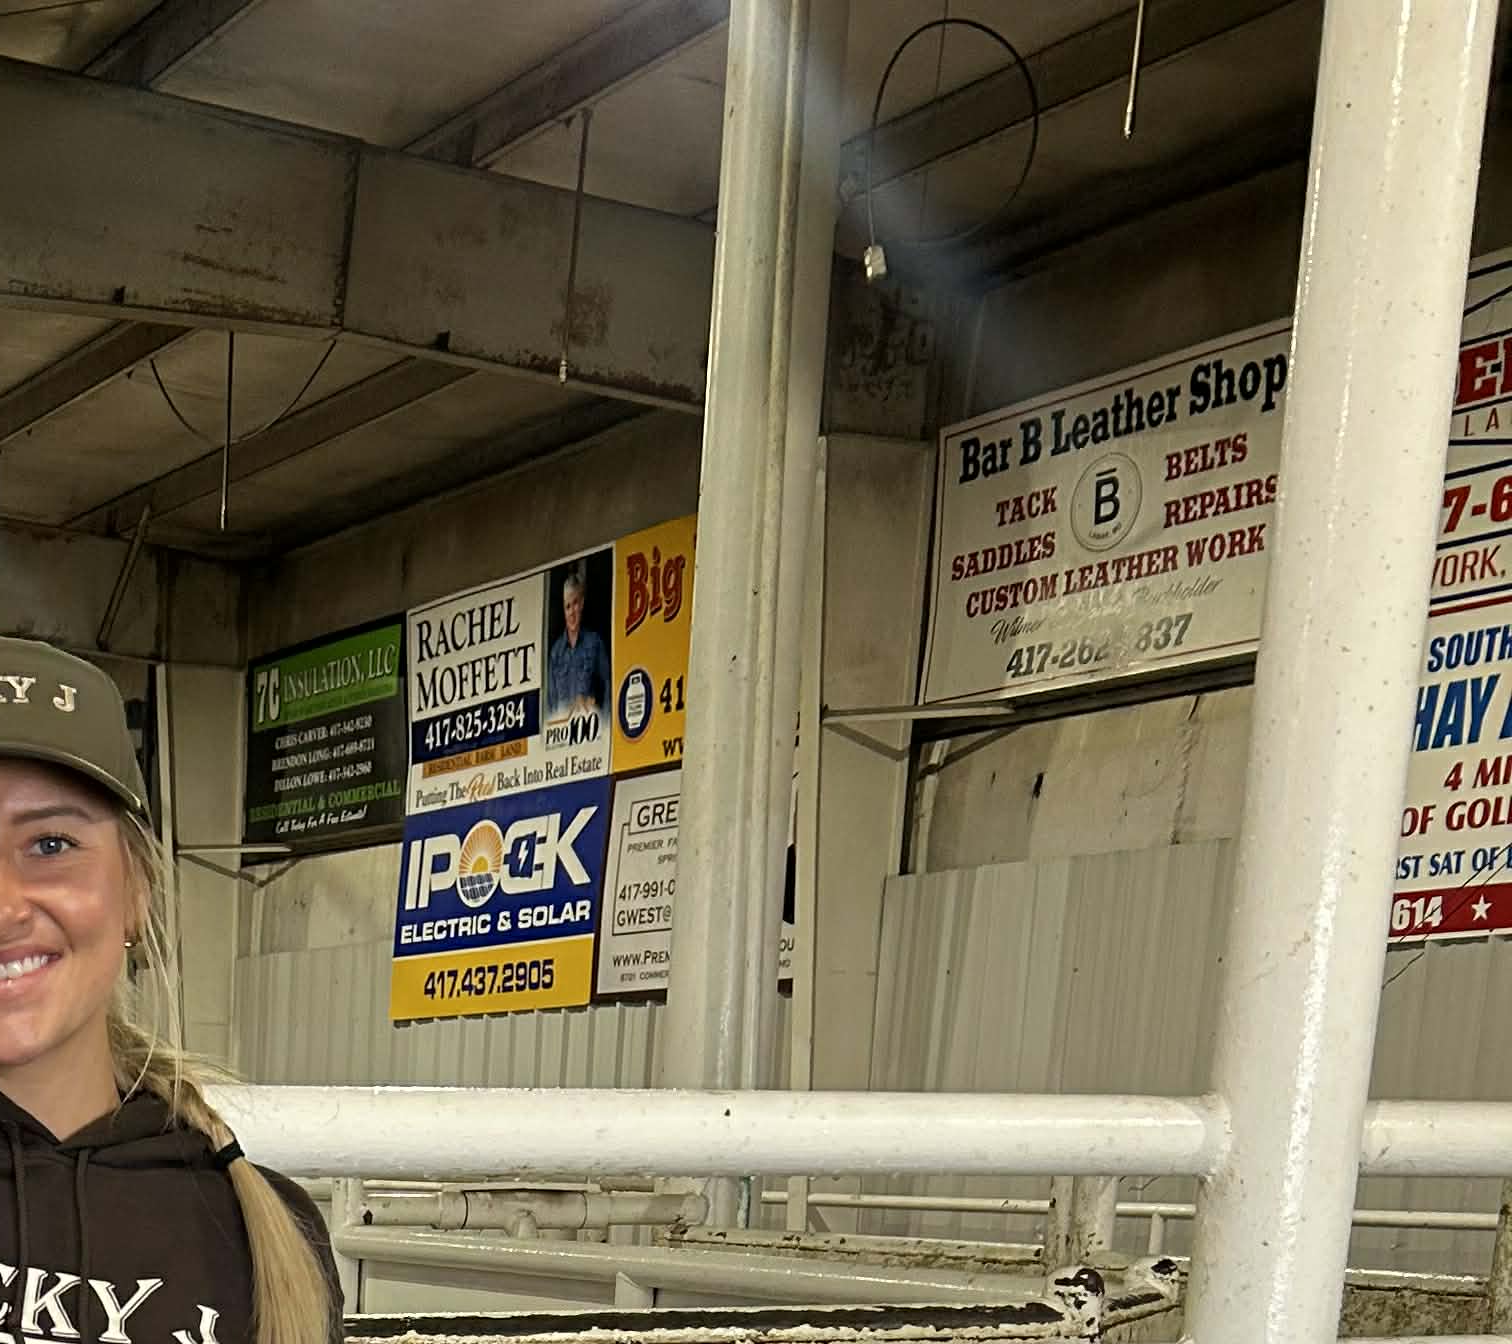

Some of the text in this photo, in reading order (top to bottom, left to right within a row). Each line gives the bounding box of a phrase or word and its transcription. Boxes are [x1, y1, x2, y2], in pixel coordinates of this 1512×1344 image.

[959, 353, 1287, 484] Bar B Leather Shop
[1165, 432, 1249, 482] BELTS
[996, 486, 1059, 527] TACK
[1163, 474, 1278, 528] REPAIRS
[952, 531, 1056, 581] SADDLES
[966, 573, 1059, 618] CUSTOM
[1064, 545, 1180, 595] LEATHER
[1186, 523, 1267, 567] WORK
[625, 546, 686, 637] Big
[417, 597, 520, 664] RACHEL
[52, 684, 77, 712] J
[283, 654, 364, 703] INSULATION,
[368, 644, 395, 679] LLC
[417, 642, 536, 712] MOFFETT
[425, 698, 525, 752] 417-825-3284
[1414, 673, 1501, 752] HAY
[498, 768, 521, 791] Back
[523, 765, 544, 785] Into
[546, 757, 568, 782] Real
[571, 756, 602, 776] Estate
[1444, 761, 1464, 791] 4
[627, 838, 663, 854] PREMIER
[1401, 805, 1436, 837] OF
[1429, 851, 1465, 877] SAT
[1472, 847, 1500, 873] OF
[400, 900, 591, 944] ELECTRIC & SOLAR
[424, 959, 554, 1000] 417.437.2905
